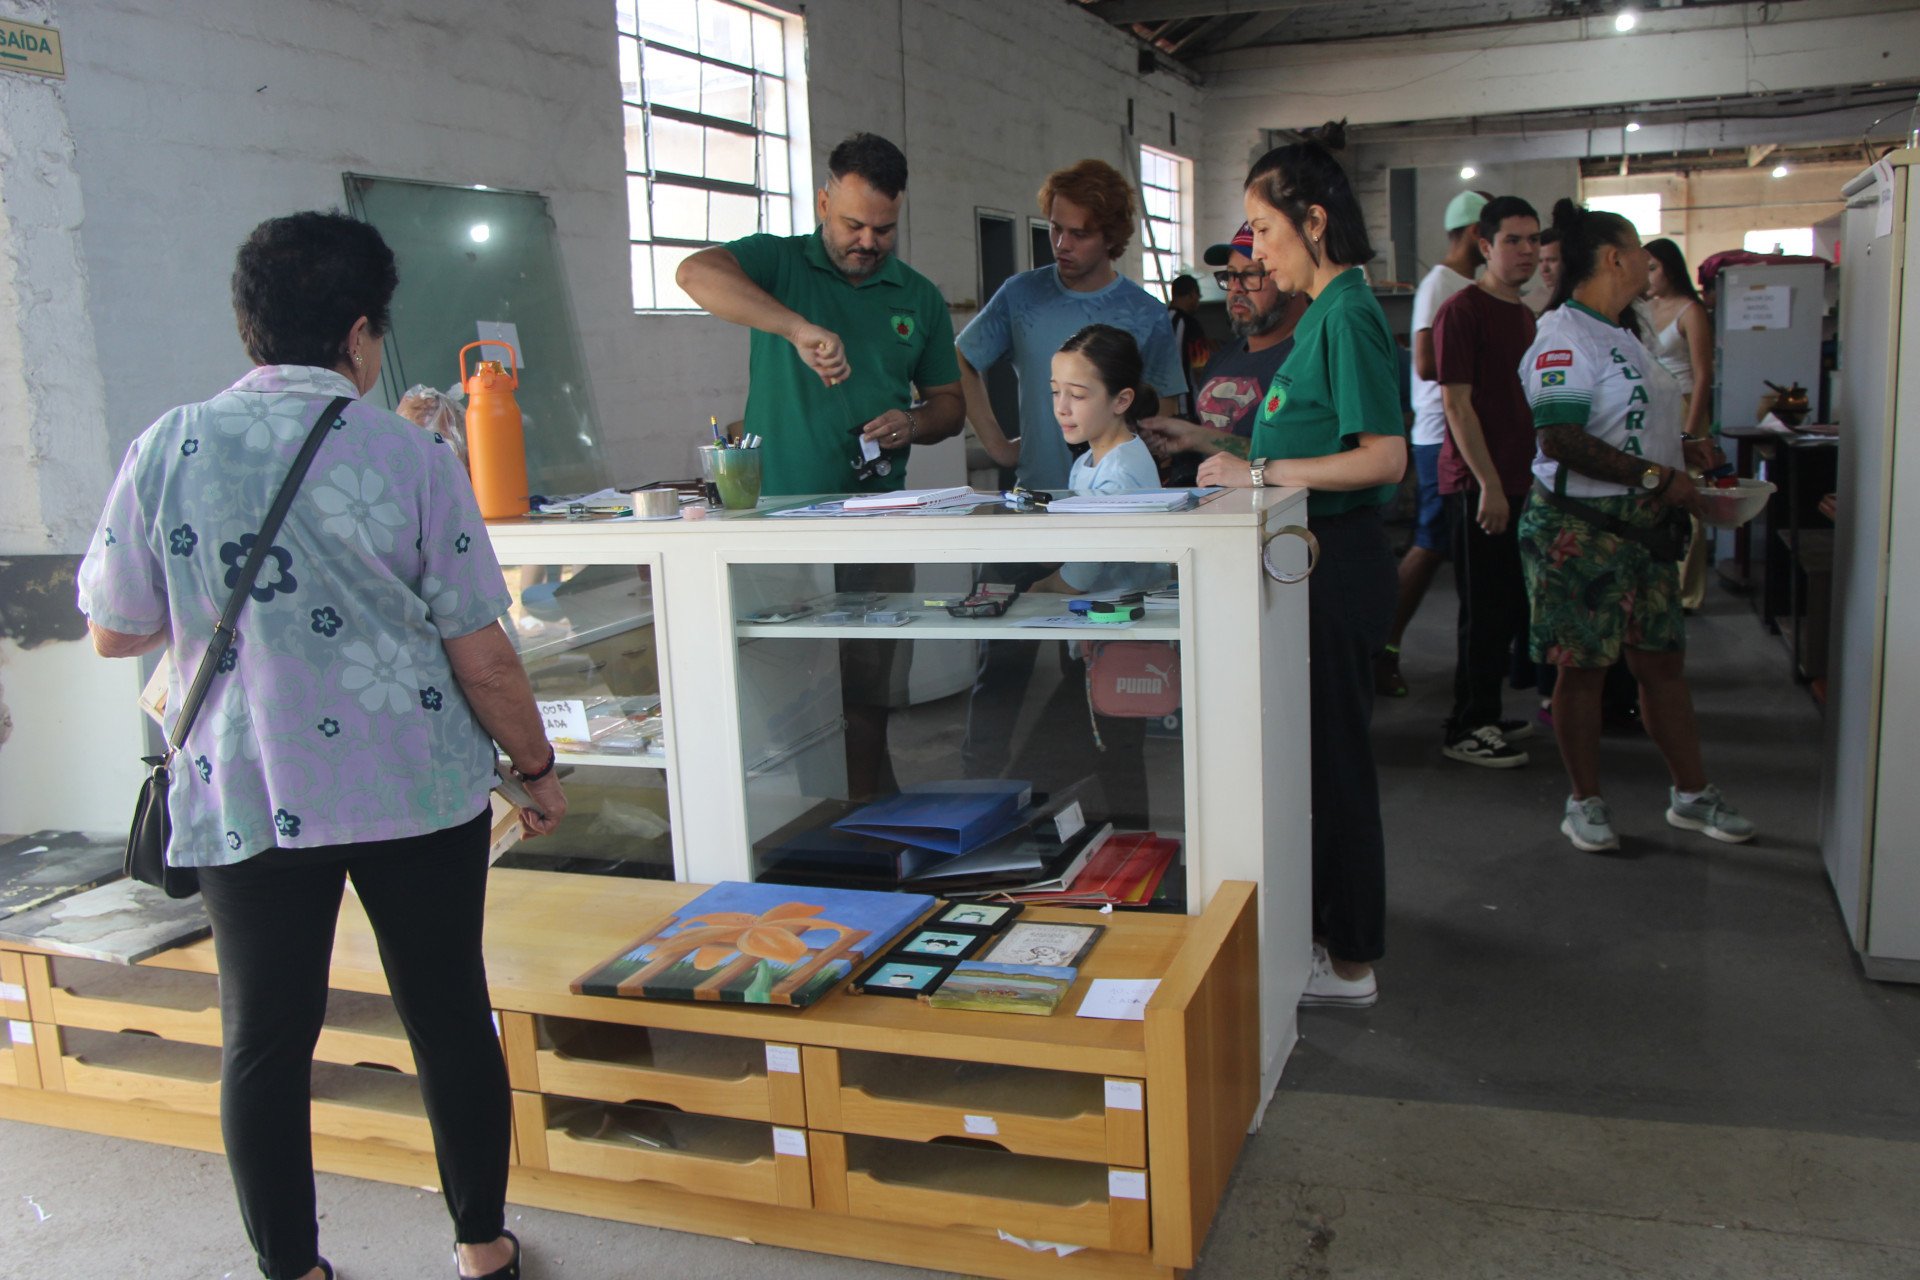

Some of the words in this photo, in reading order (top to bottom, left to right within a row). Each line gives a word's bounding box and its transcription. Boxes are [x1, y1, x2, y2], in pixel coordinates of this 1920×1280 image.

[0, 28, 52, 55] SAÍDA
[1116, 678, 1161, 693] PUMA
[545, 718, 568, 729] ADA
